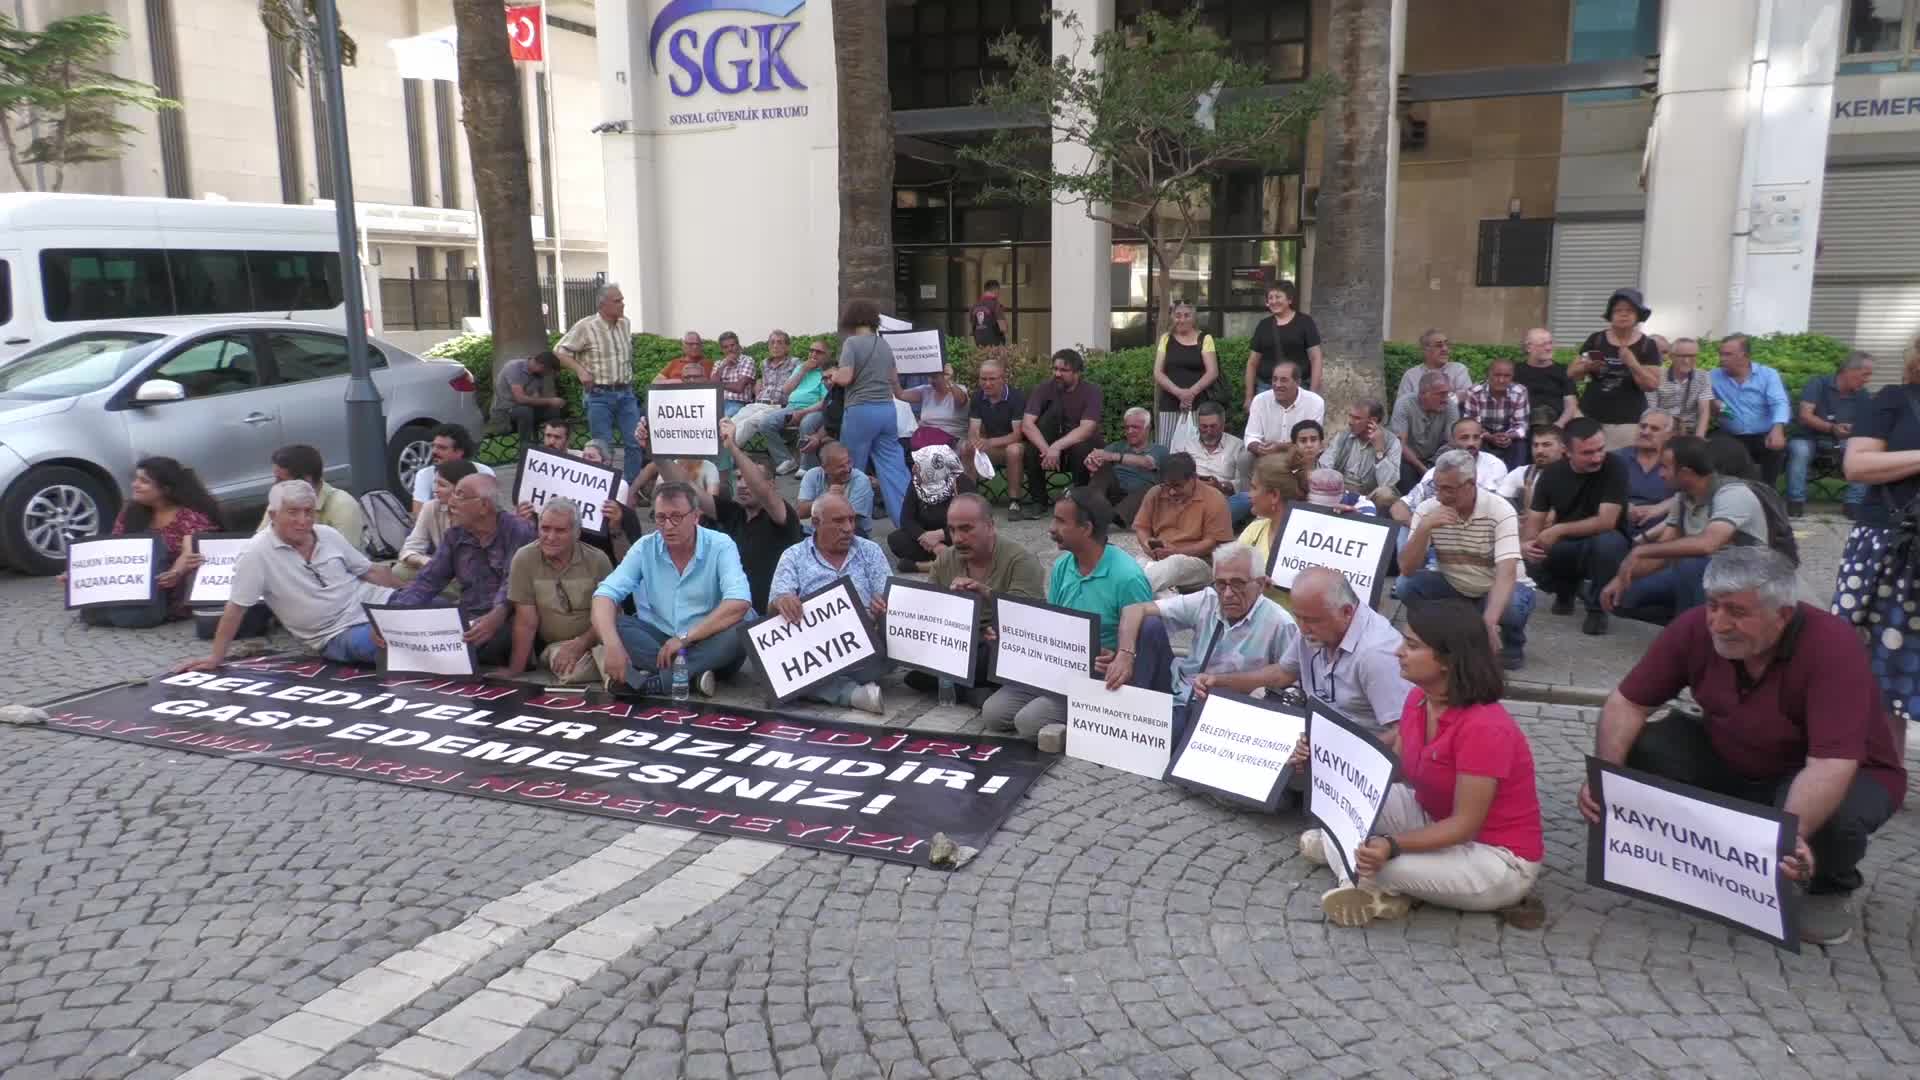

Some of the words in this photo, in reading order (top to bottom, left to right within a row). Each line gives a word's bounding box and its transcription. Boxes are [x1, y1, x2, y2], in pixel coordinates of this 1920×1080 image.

[669, 22, 808, 97] SGK
[670, 113, 705, 125] SOSYAL
[706, 108, 760, 123] GÜVENLİK
[762, 106, 808, 119] KURUMU
[658, 405, 705, 419] ADALET
[653, 427, 716, 440] NÖBETİNDEYİZ!
[528, 458, 608, 492] KAYYUMA
[1296, 530, 1368, 558] ADALET
[74, 574, 144, 588] KAZANACAK
[757, 598, 851, 651] KAYYUMA
[888, 609, 916, 620] KAYYUM
[431, 642, 463, 652] HAYIR
[889, 625, 938, 644] DARBEYE
[940, 635, 968, 652] HAYIR
[1001, 641, 1026, 655] GASPA
[1002, 625, 1048, 644] BELEDİYELER
[781, 631, 861, 682] HAYIR
[1072, 701, 1100, 713] KAYYUM
[159, 671, 598, 740] BELEDİYELER
[599, 728, 1010, 794] BİZİMDİR!
[523, 693, 1003, 761] DARBEDİR!
[1073, 718, 1128, 740] KAYYUMA
[1131, 730, 1165, 749] HAYIR
[1200, 723, 1251, 744] BELEDİYELER
[151, 699, 335, 730] GASP
[327, 722, 897, 814] EDEMEZSİNİZ!
[1190, 741, 1216, 754] GASPA
[280, 746, 465, 784] KARŞI
[469, 774, 925, 854] NÖBETTEYİZ!
[1313, 775, 1339, 805] KABUL
[1612, 804, 1768, 876] KAYYUMLARI
[1609, 838, 1667, 866] KABUL
[1672, 857, 1777, 909] ETMİYORUZ
